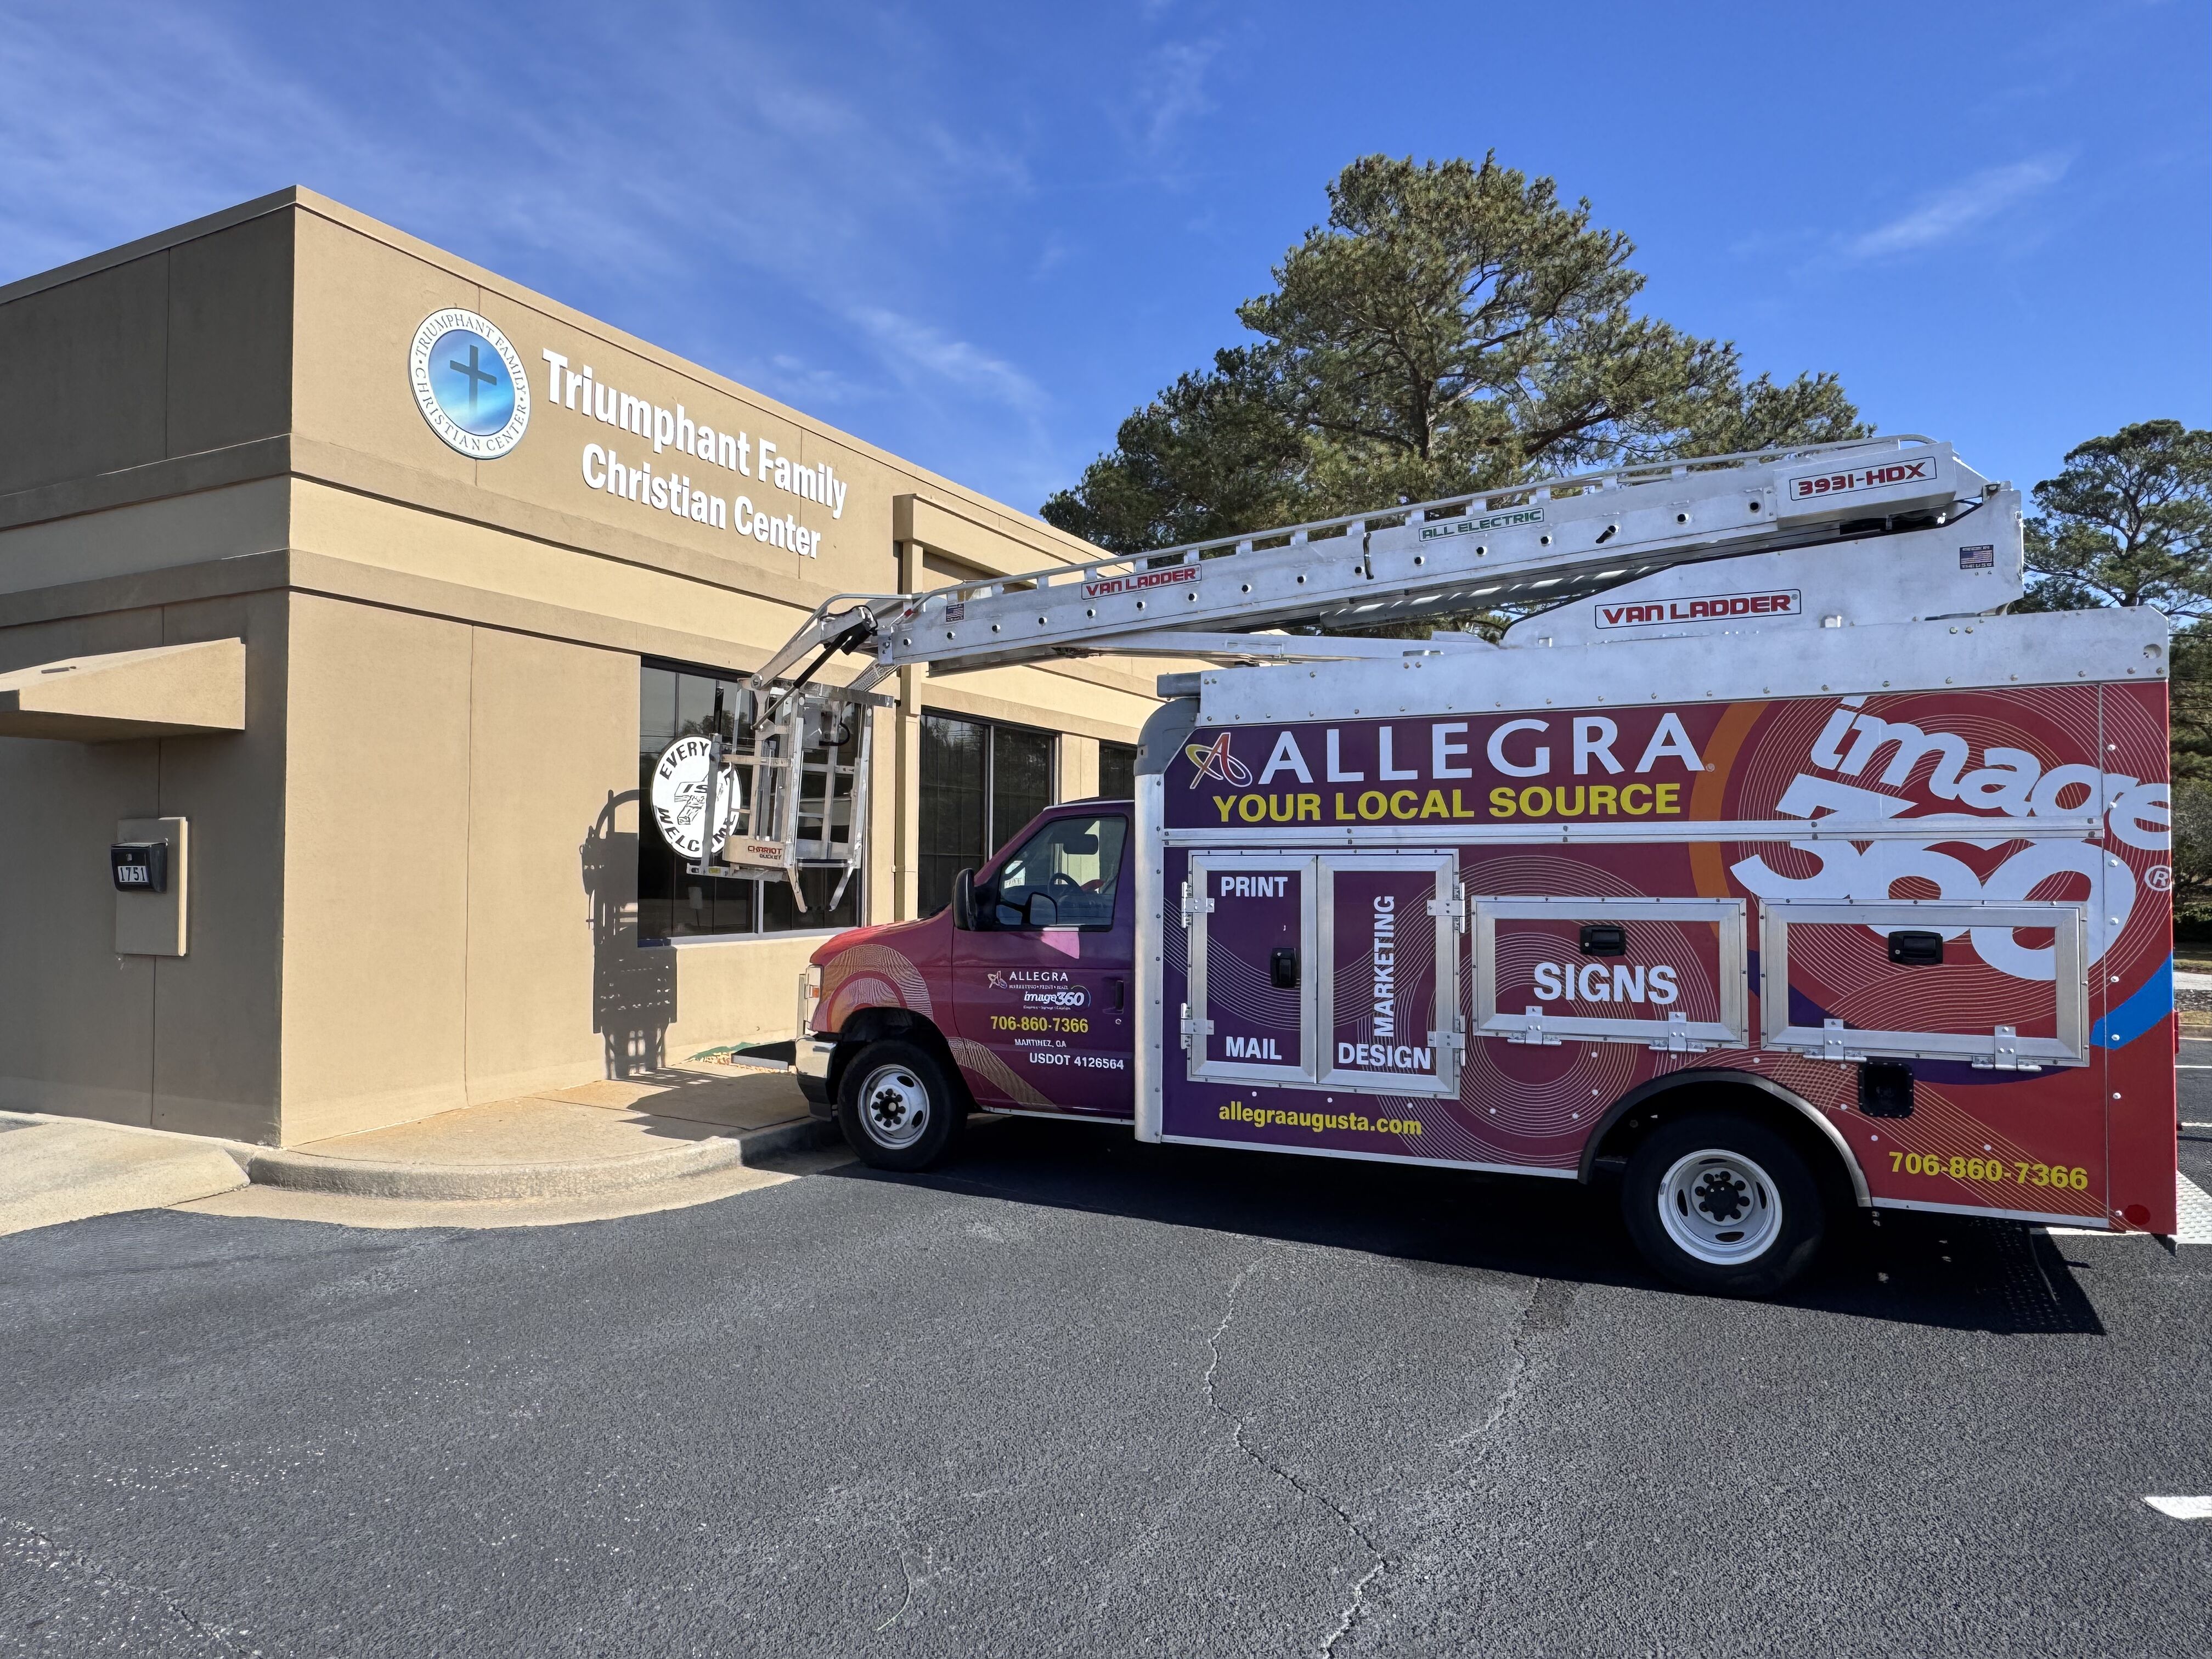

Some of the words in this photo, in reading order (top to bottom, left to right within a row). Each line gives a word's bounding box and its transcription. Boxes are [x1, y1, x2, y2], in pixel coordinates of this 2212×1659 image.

[415, 314, 495, 357] TRIUMPHANT
[495, 336, 527, 395] FAMILY
[415, 367, 481, 451] CHRISTIAN
[486, 404, 527, 452] CENTER
[543, 348, 751, 477] Triumphant
[758, 438, 848, 520] Family
[582, 443, 726, 530] Christian
[734, 495, 821, 559] Center
[1423, 526, 1455, 539] ALL
[1458, 510, 1541, 533] ELECTRIC
[1086, 580, 1122, 596] VAN
[1125, 568, 1196, 590] LADDER
[1602, 605, 1664, 624] VAN
[1670, 594, 1791, 620] LADDER
[1257, 713, 1706, 785] ALLEGRA
[1212, 793, 1321, 822] YOUR
[1335, 789, 1475, 821] LOCAL
[1488, 783, 1680, 817] SOURCE
[120, 867, 145, 881] 1751
[1221, 877, 1288, 897] PRINT
[1009, 971, 1069, 982] ALLEGRA
[1374, 896, 1395, 1037] MARKETING
[1534, 962, 1679, 1005] SIGNS
[990, 1016, 1088, 1033] 706-860-7366
[1029, 1052, 1070, 1065] USDOT
[1074, 1056, 1124, 1070] 4126564
[1226, 1036, 1282, 1060] MAIL
[1338, 1042, 1431, 1069] DESIGN
[1218, 1101, 1422, 1135] allegraaugusta.com
[1888, 1151, 2089, 1190] 706-860-7366
